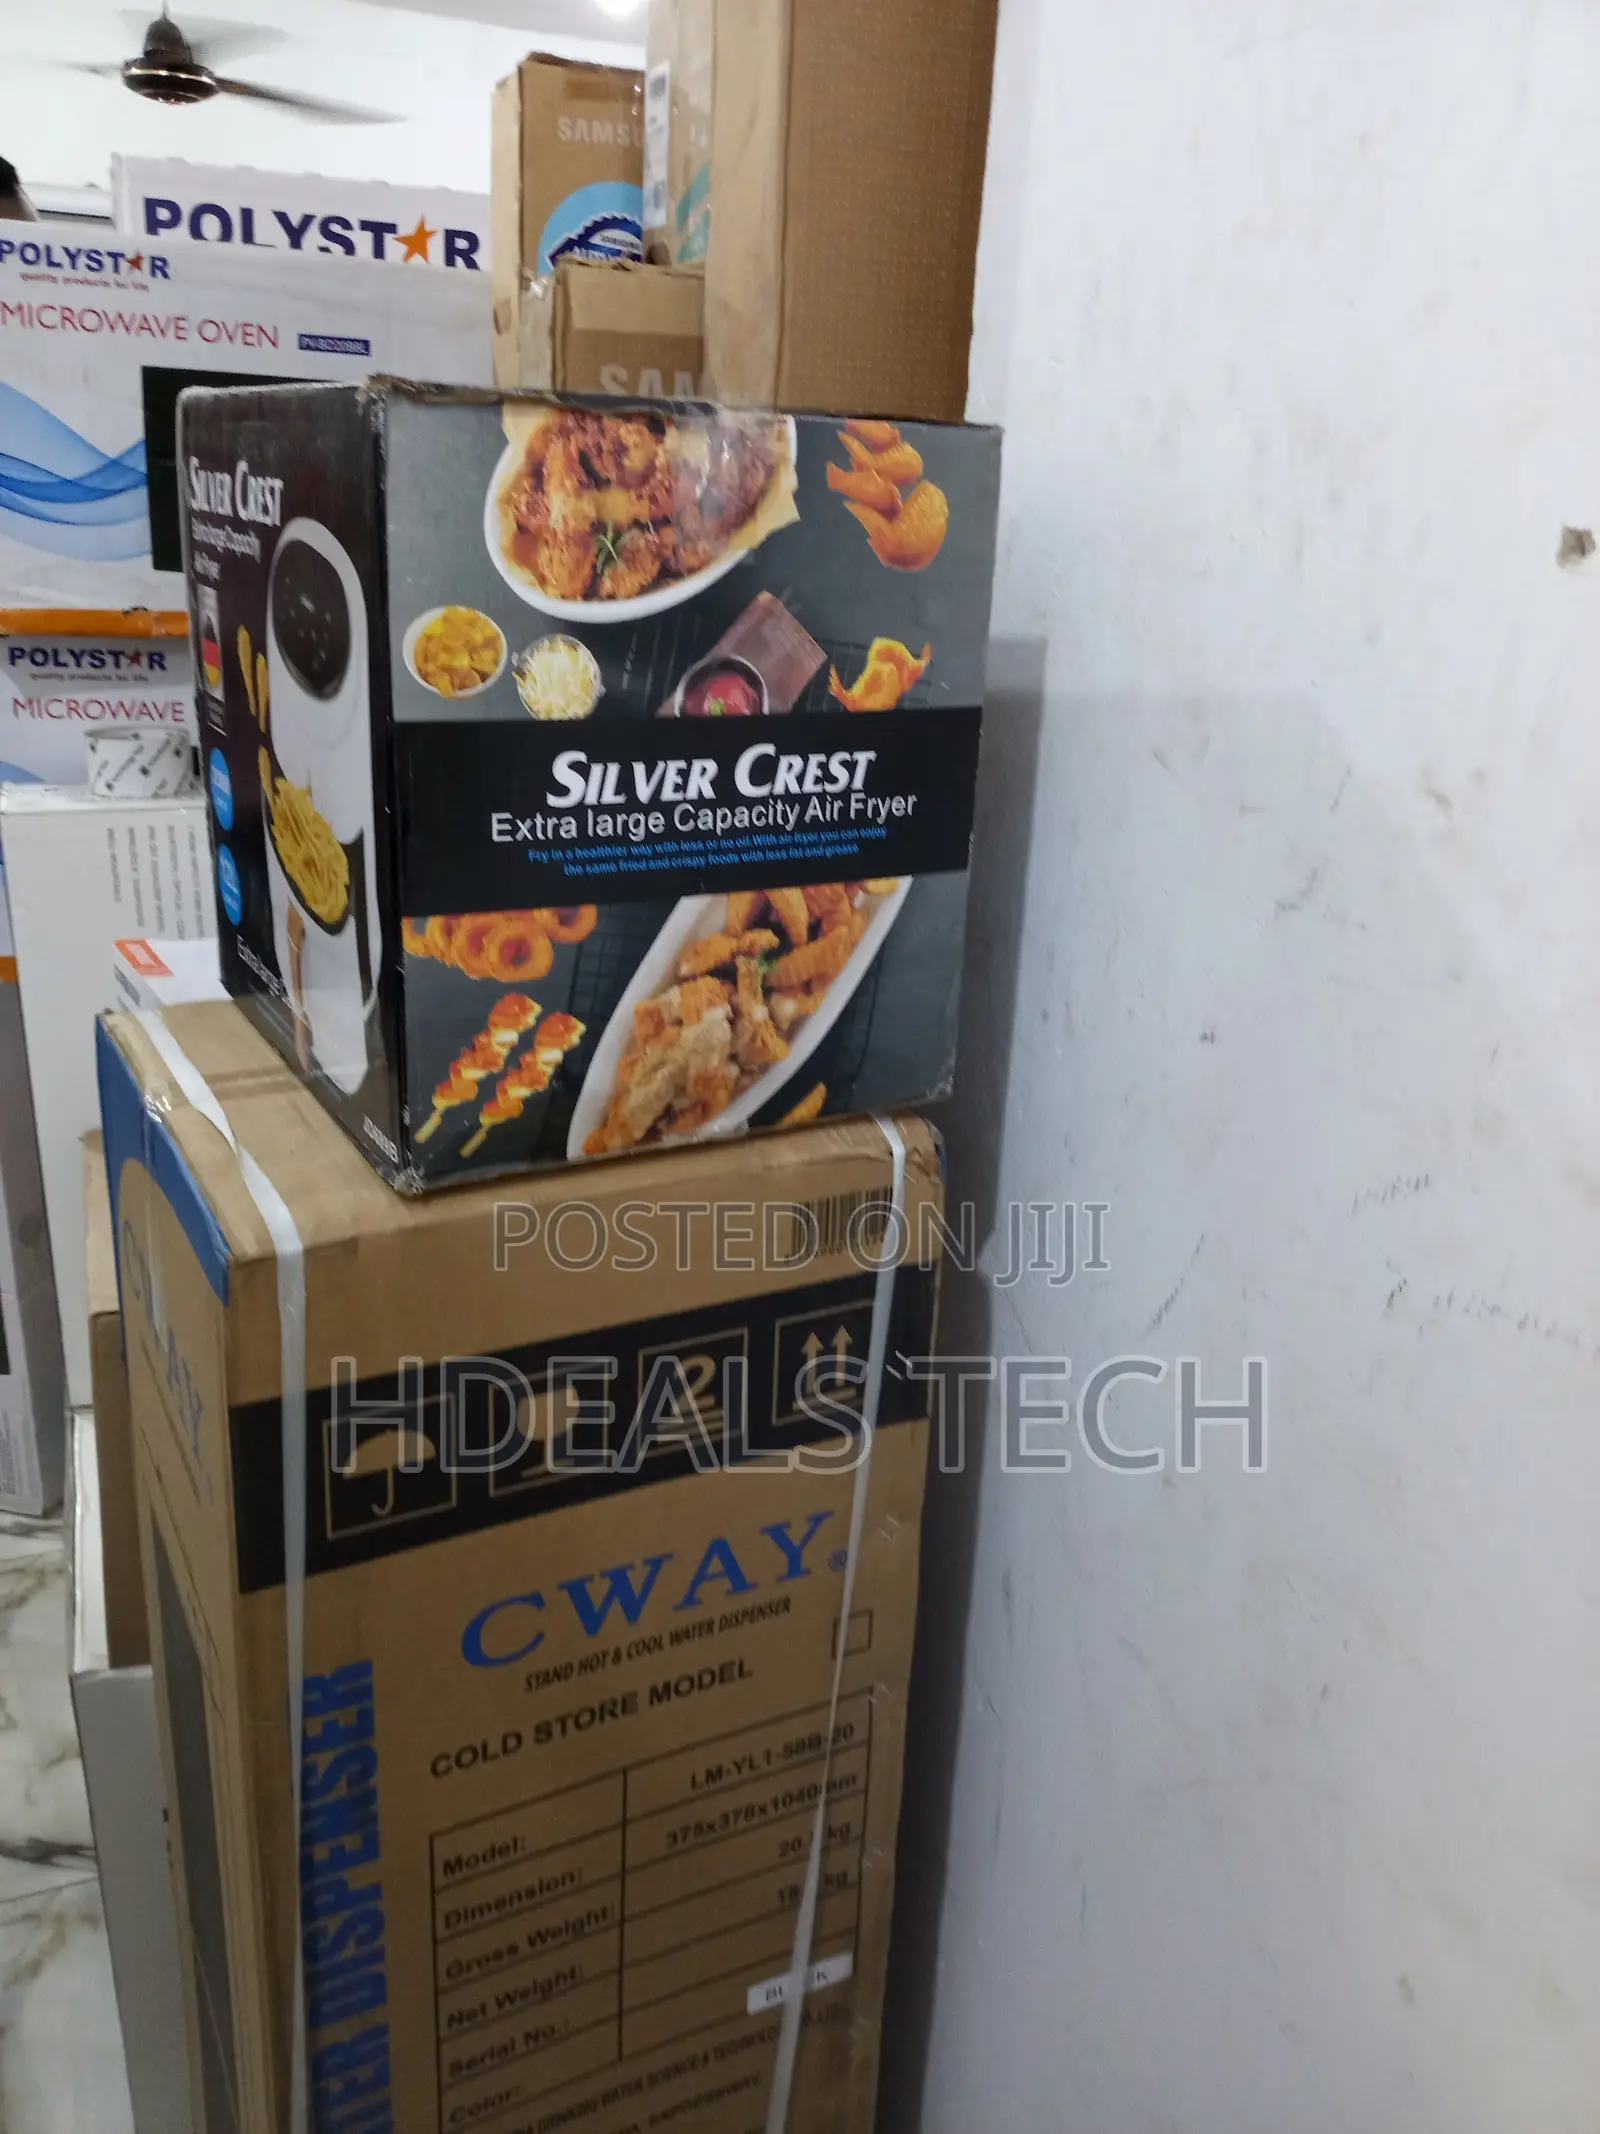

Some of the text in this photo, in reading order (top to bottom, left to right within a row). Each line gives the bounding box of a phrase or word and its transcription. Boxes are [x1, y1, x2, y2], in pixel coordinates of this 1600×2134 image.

[0, 300, 188, 341] MICROWAVE
[198, 319, 279, 349] OVEN
[13, 697, 185, 722] MICROWAVE
[546, 742, 877, 808] SILVER CREST
[491, 792, 918, 843] Extra large Capacity Air Fryer
[461, 1510, 834, 1669] CWAY
[523, 1595, 792, 1692] STAND HOT & COOL WATER DISPENSER
[430, 1657, 754, 1779] COLD STORE MODEL
[301, 1659, 388, 2029] DISPENSER
[442, 1835, 526, 1877] Model:
[445, 1941, 520, 1980] Gross
[447, 2001, 487, 2031] Net
[449, 2036, 516, 2079] Serial
